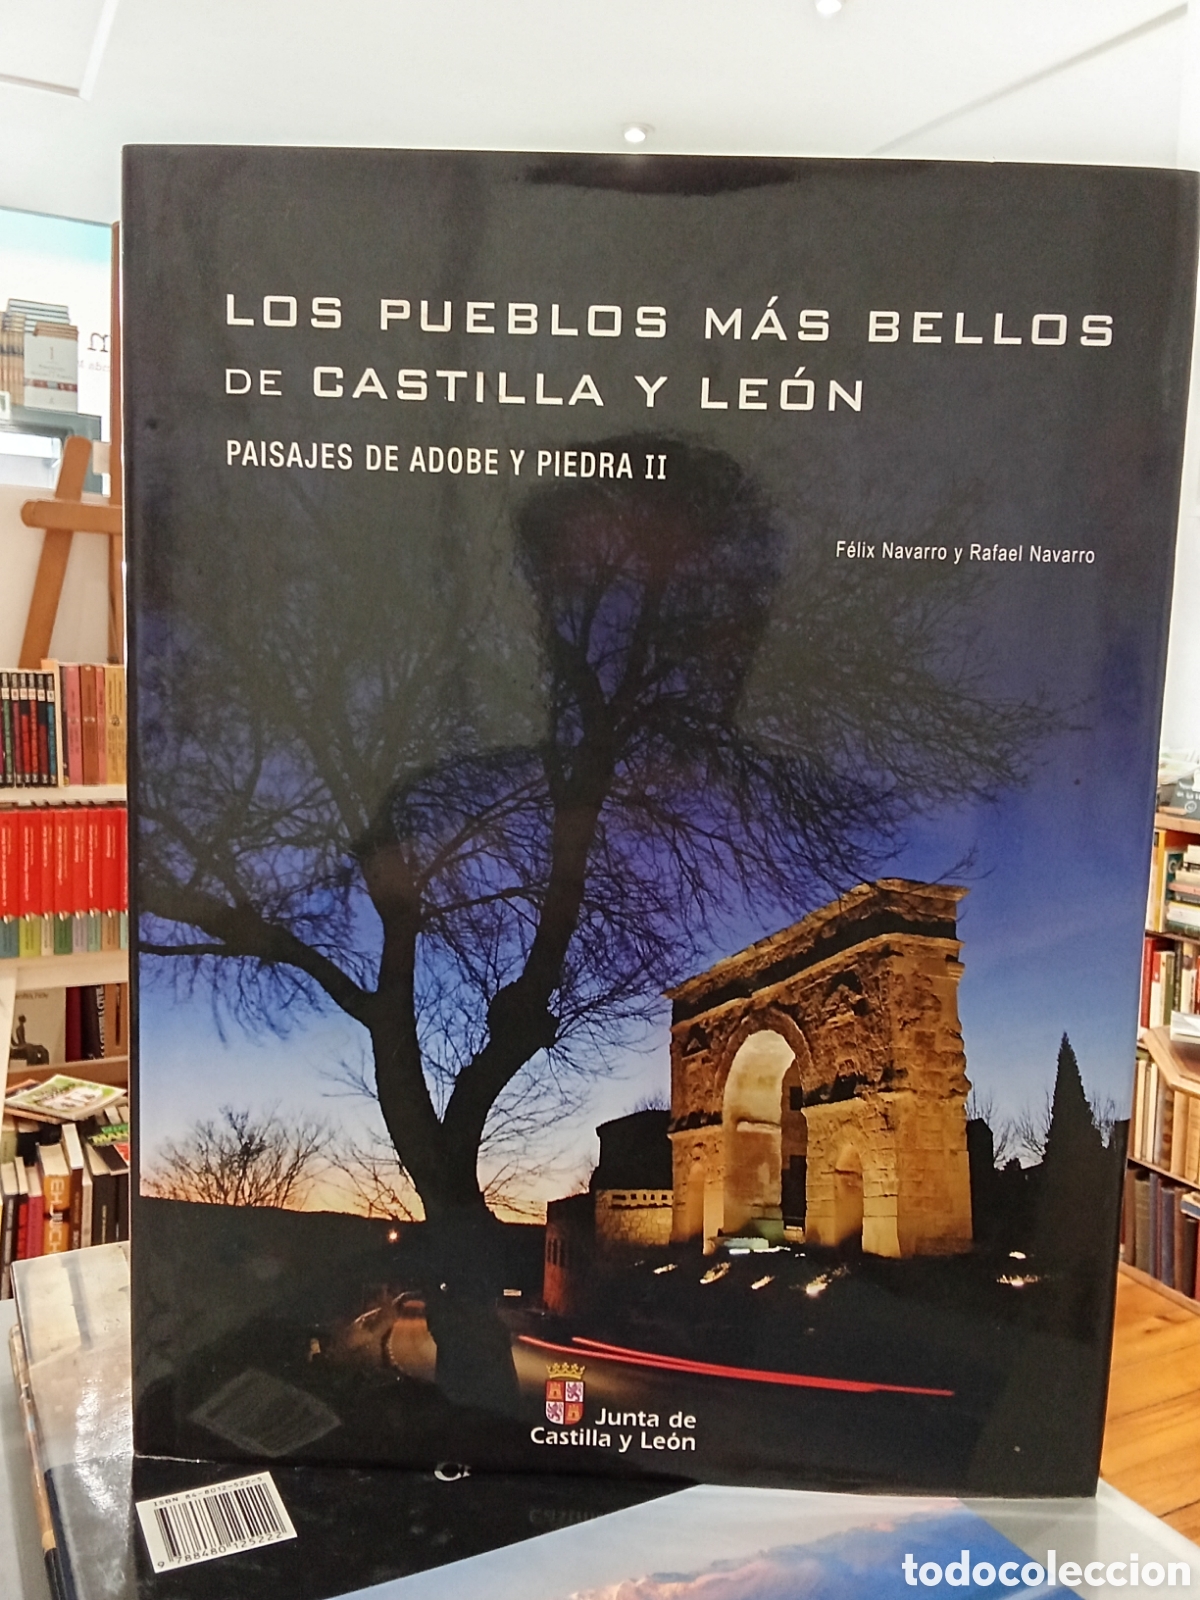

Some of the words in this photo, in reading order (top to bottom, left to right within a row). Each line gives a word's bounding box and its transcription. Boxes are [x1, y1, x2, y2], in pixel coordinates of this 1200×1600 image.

[226, 293, 342, 329] LOS
[380, 298, 667, 338] PUEBLOS
[704, 295, 830, 342] MÁS
[868, 310, 1113, 347] BELLOS
[225, 368, 282, 396] DE
[313, 366, 604, 407] CASTILLA
[634, 375, 668, 408] Y
[700, 366, 863, 412] LEÓN
[226, 439, 353, 470] PAISAJES
[366, 444, 399, 472] DE
[409, 446, 499, 475] ADOBE
[509, 449, 525, 476] Y
[537, 450, 633, 479] PIEDRA
[644, 454, 667, 480] II
[836, 540, 875, 559] Félix
[882, 541, 947, 560] Navarro
[953, 547, 963, 565] y
[969, 543, 1023, 562] Rafael
[1029, 544, 1095, 564] Navarro
[594, 1407, 660, 1427] Junta
[668, 1411, 697, 1429] de
[530, 1426, 612, 1448] Castilla
[618, 1434, 633, 1453] y
[640, 1431, 696, 1451] León
[153, 1497, 179, 1507] ISBN
[185, 1477, 263, 1500] 84-8012-522-5
[157, 1560, 166, 1569] 9
[175, 1546, 227, 1564] 788480
[233, 1532, 283, 1550] 125222
